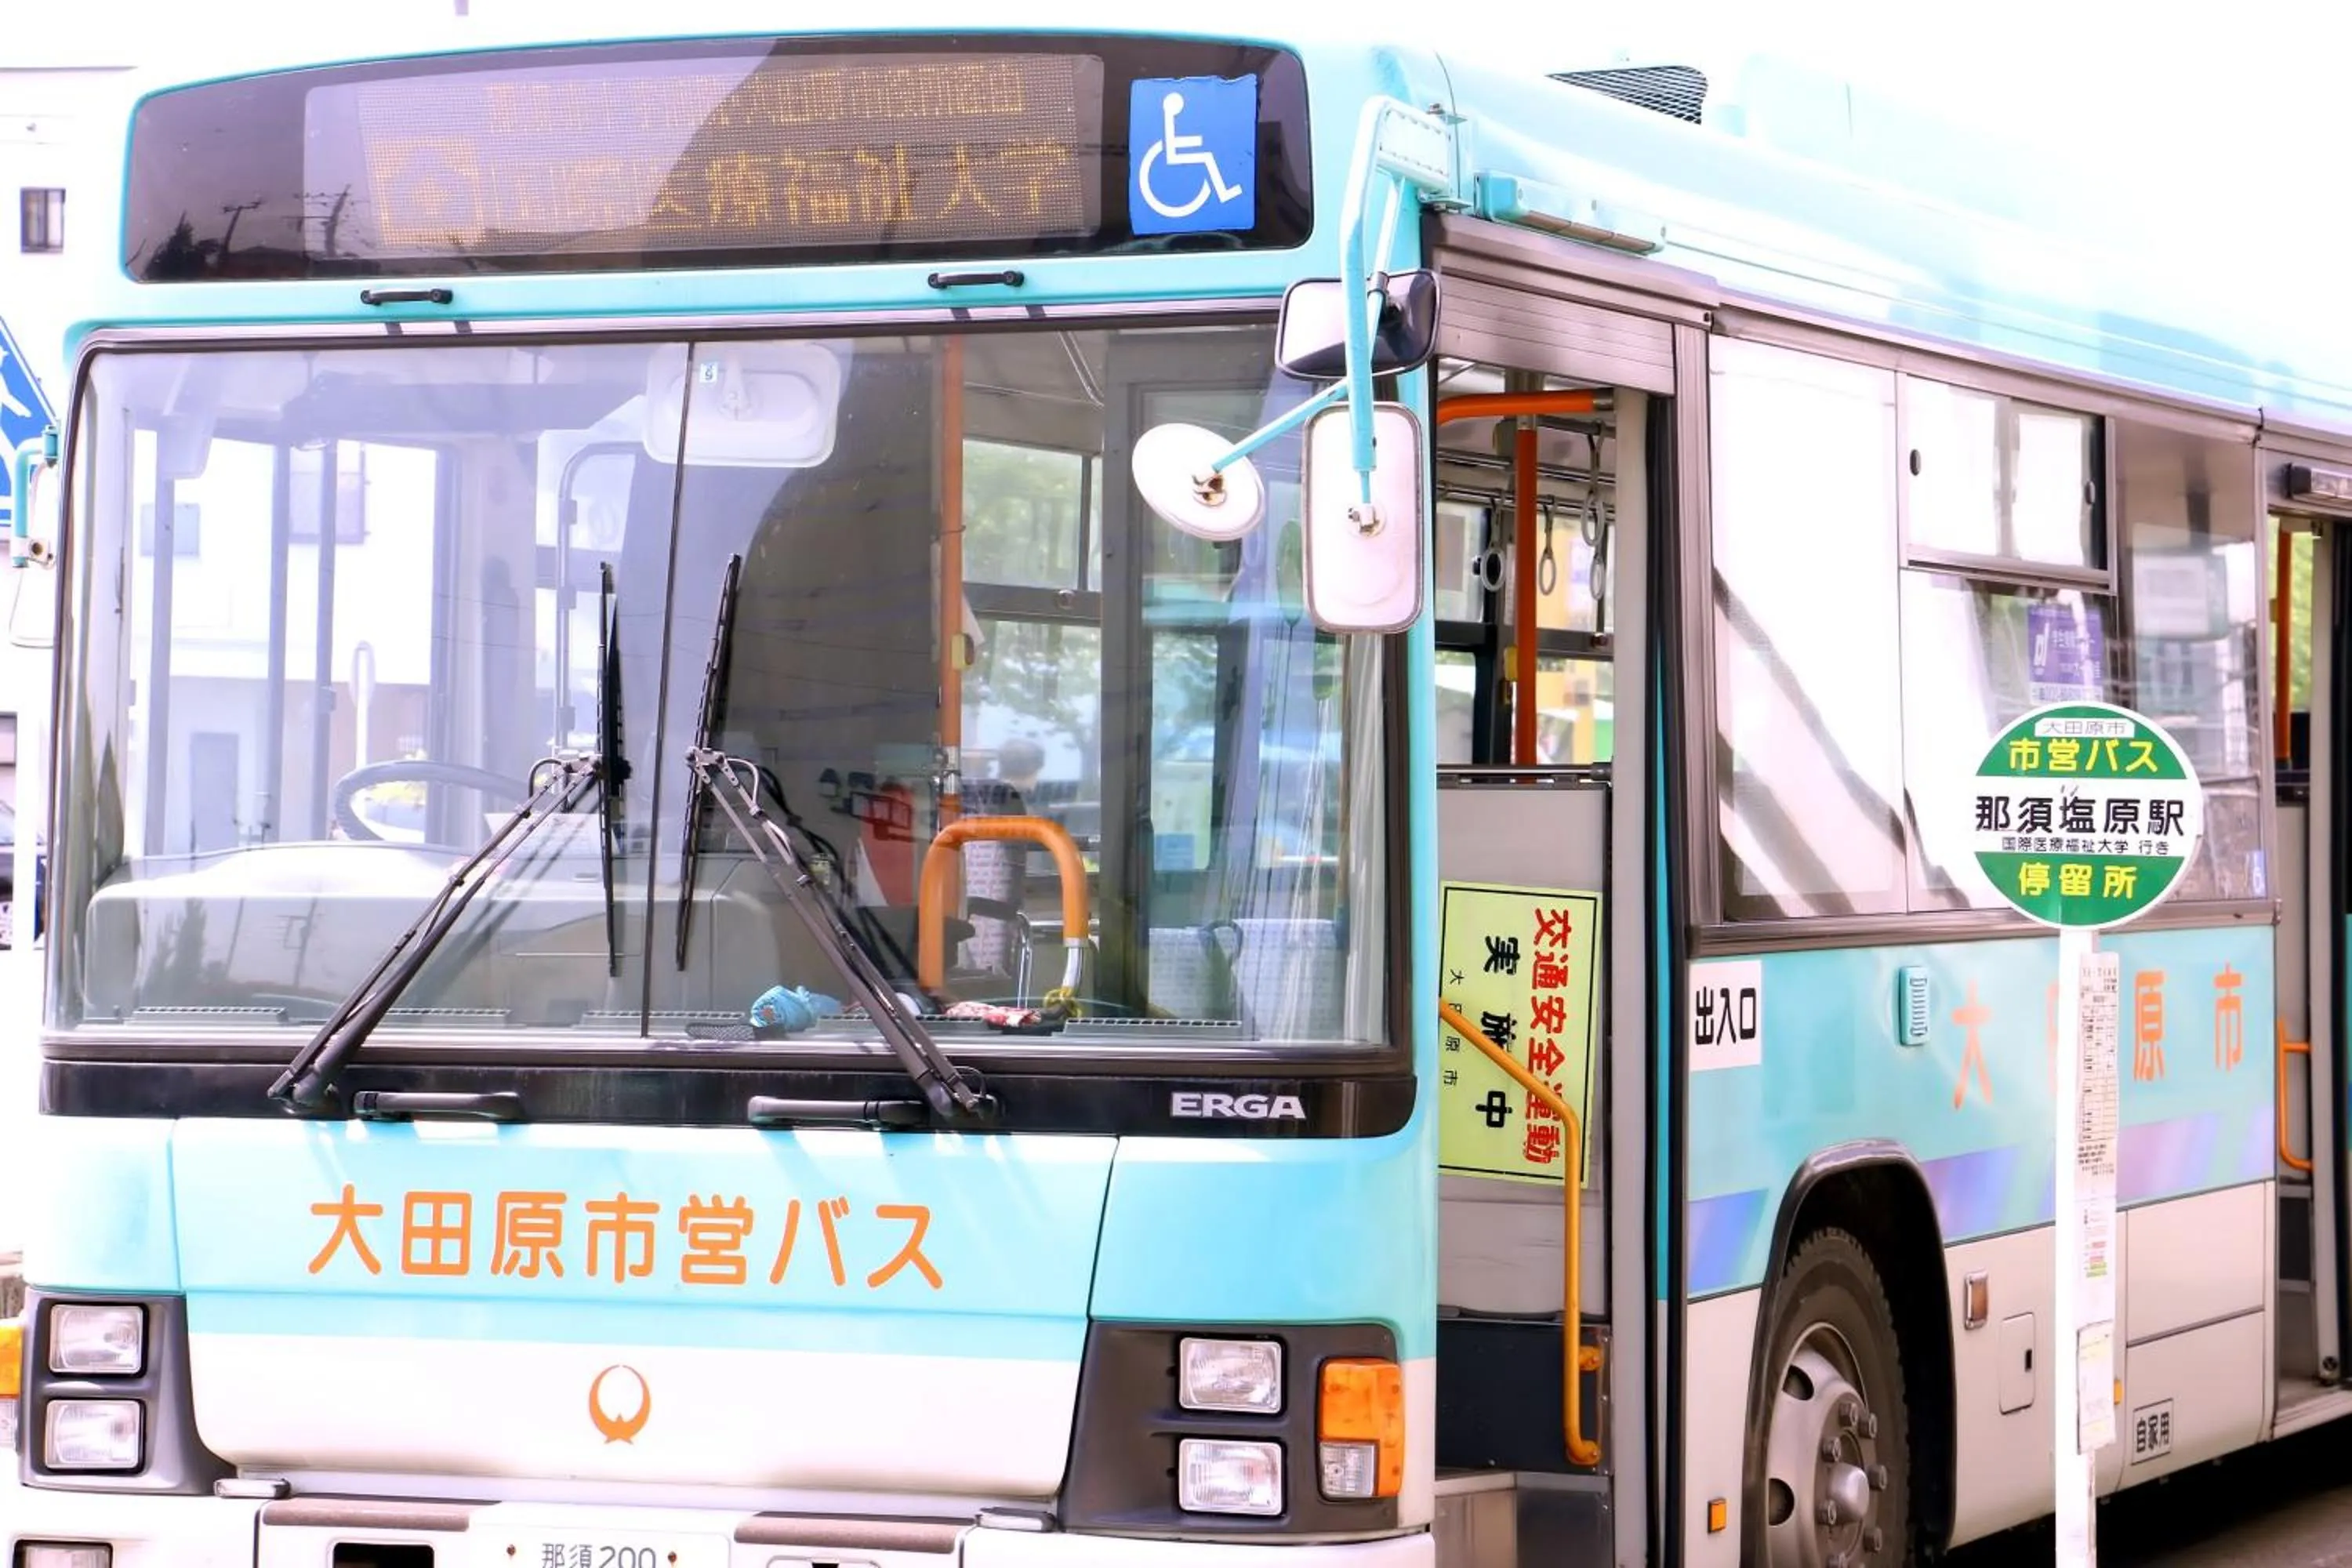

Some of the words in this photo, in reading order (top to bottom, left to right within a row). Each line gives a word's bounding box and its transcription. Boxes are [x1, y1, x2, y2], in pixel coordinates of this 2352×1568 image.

[2042, 720, 2127, 735] 大田原市
[2009, 738, 2158, 772] 市営バス
[1975, 795, 2184, 837] 那須塩原駅
[2002, 837, 2129, 855] 国際医療福祉大学
[2018, 862, 2138, 899] 停留所
[1694, 985, 1757, 1046] 出入口
[1951, 960, 2245, 1112] 大原市
[1169, 1091, 1307, 1120] ERGA
[307, 1182, 946, 1292] 大田原市営バス
